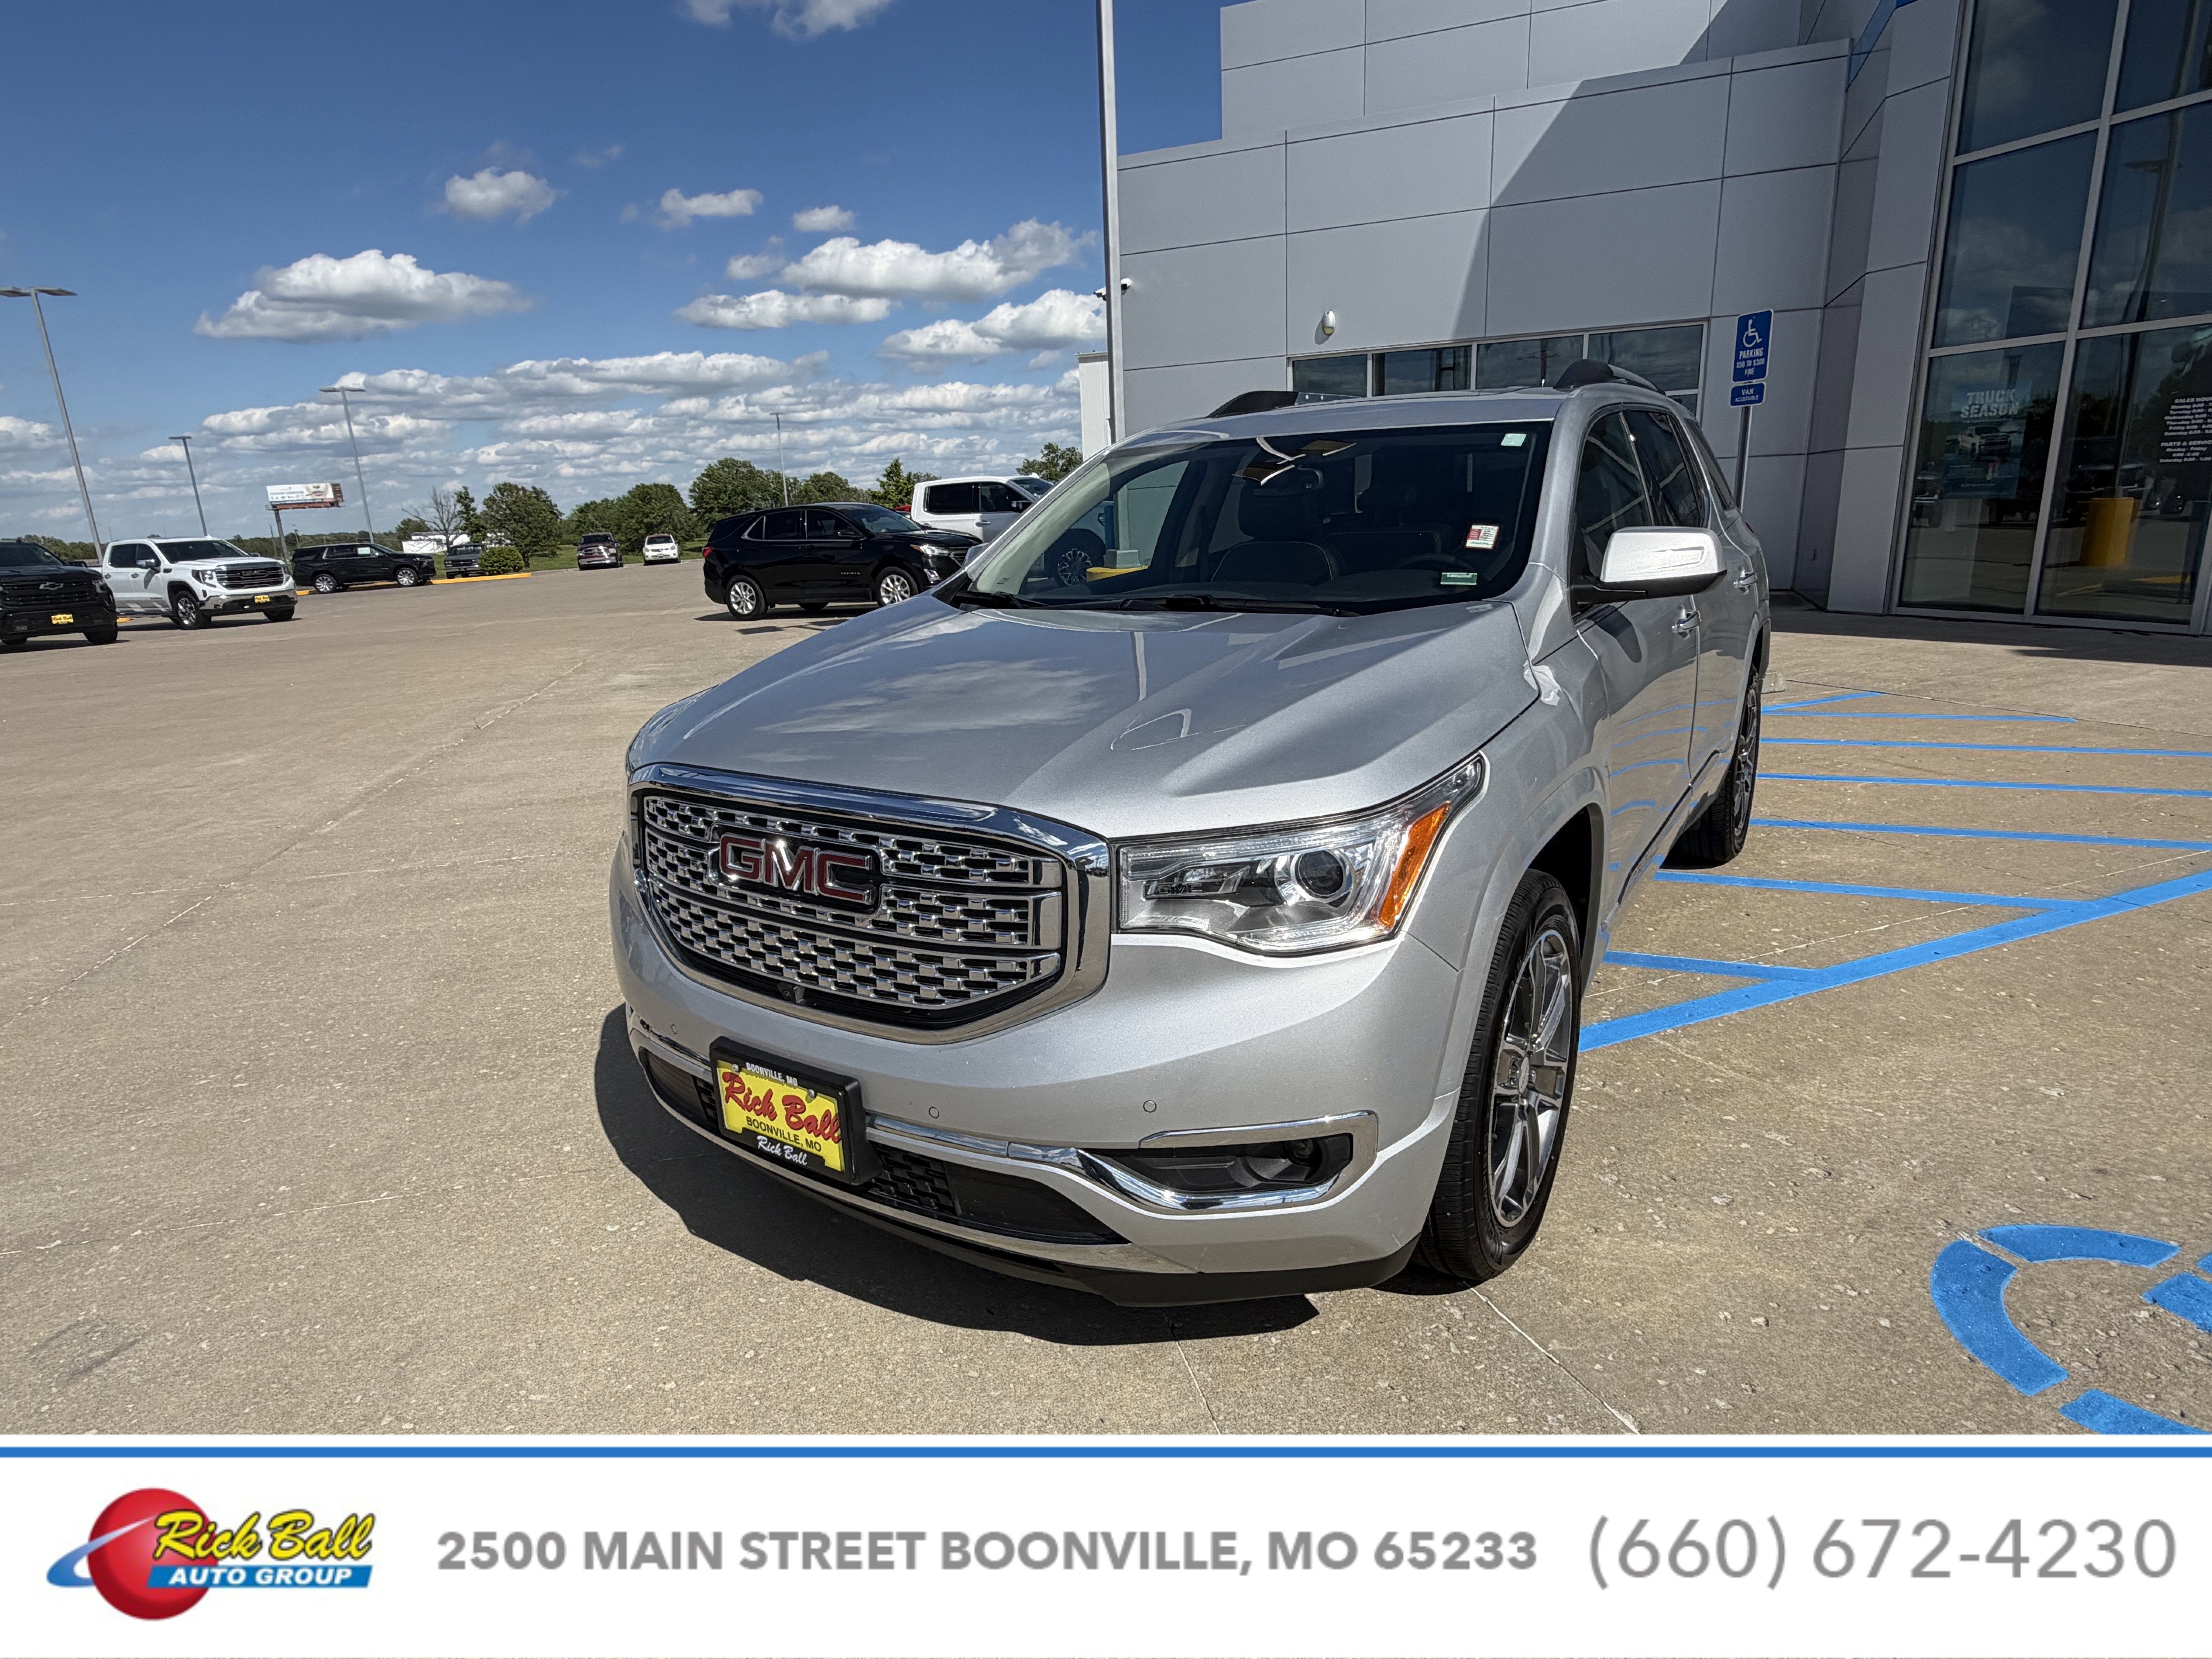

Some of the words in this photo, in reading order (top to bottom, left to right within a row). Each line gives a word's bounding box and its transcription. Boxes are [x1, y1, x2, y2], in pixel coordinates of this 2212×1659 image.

[1739, 347, 1764, 359] PARKING
[1960, 402, 2019, 418] SEASON
[1966, 389, 2016, 405] TRUCK
[720, 832, 878, 905] GMC
[746, 1062, 785, 1082] BOONVILLE,
[786, 1076, 798, 1087] MO
[722, 1072, 777, 1121] Rick
[781, 1095, 841, 1144] Ball
[746, 1116, 803, 1148] BOONVILLE,
[805, 1139, 822, 1152] MO
[757, 1135, 781, 1156] Rick
[783, 1145, 807, 1166] Ball
